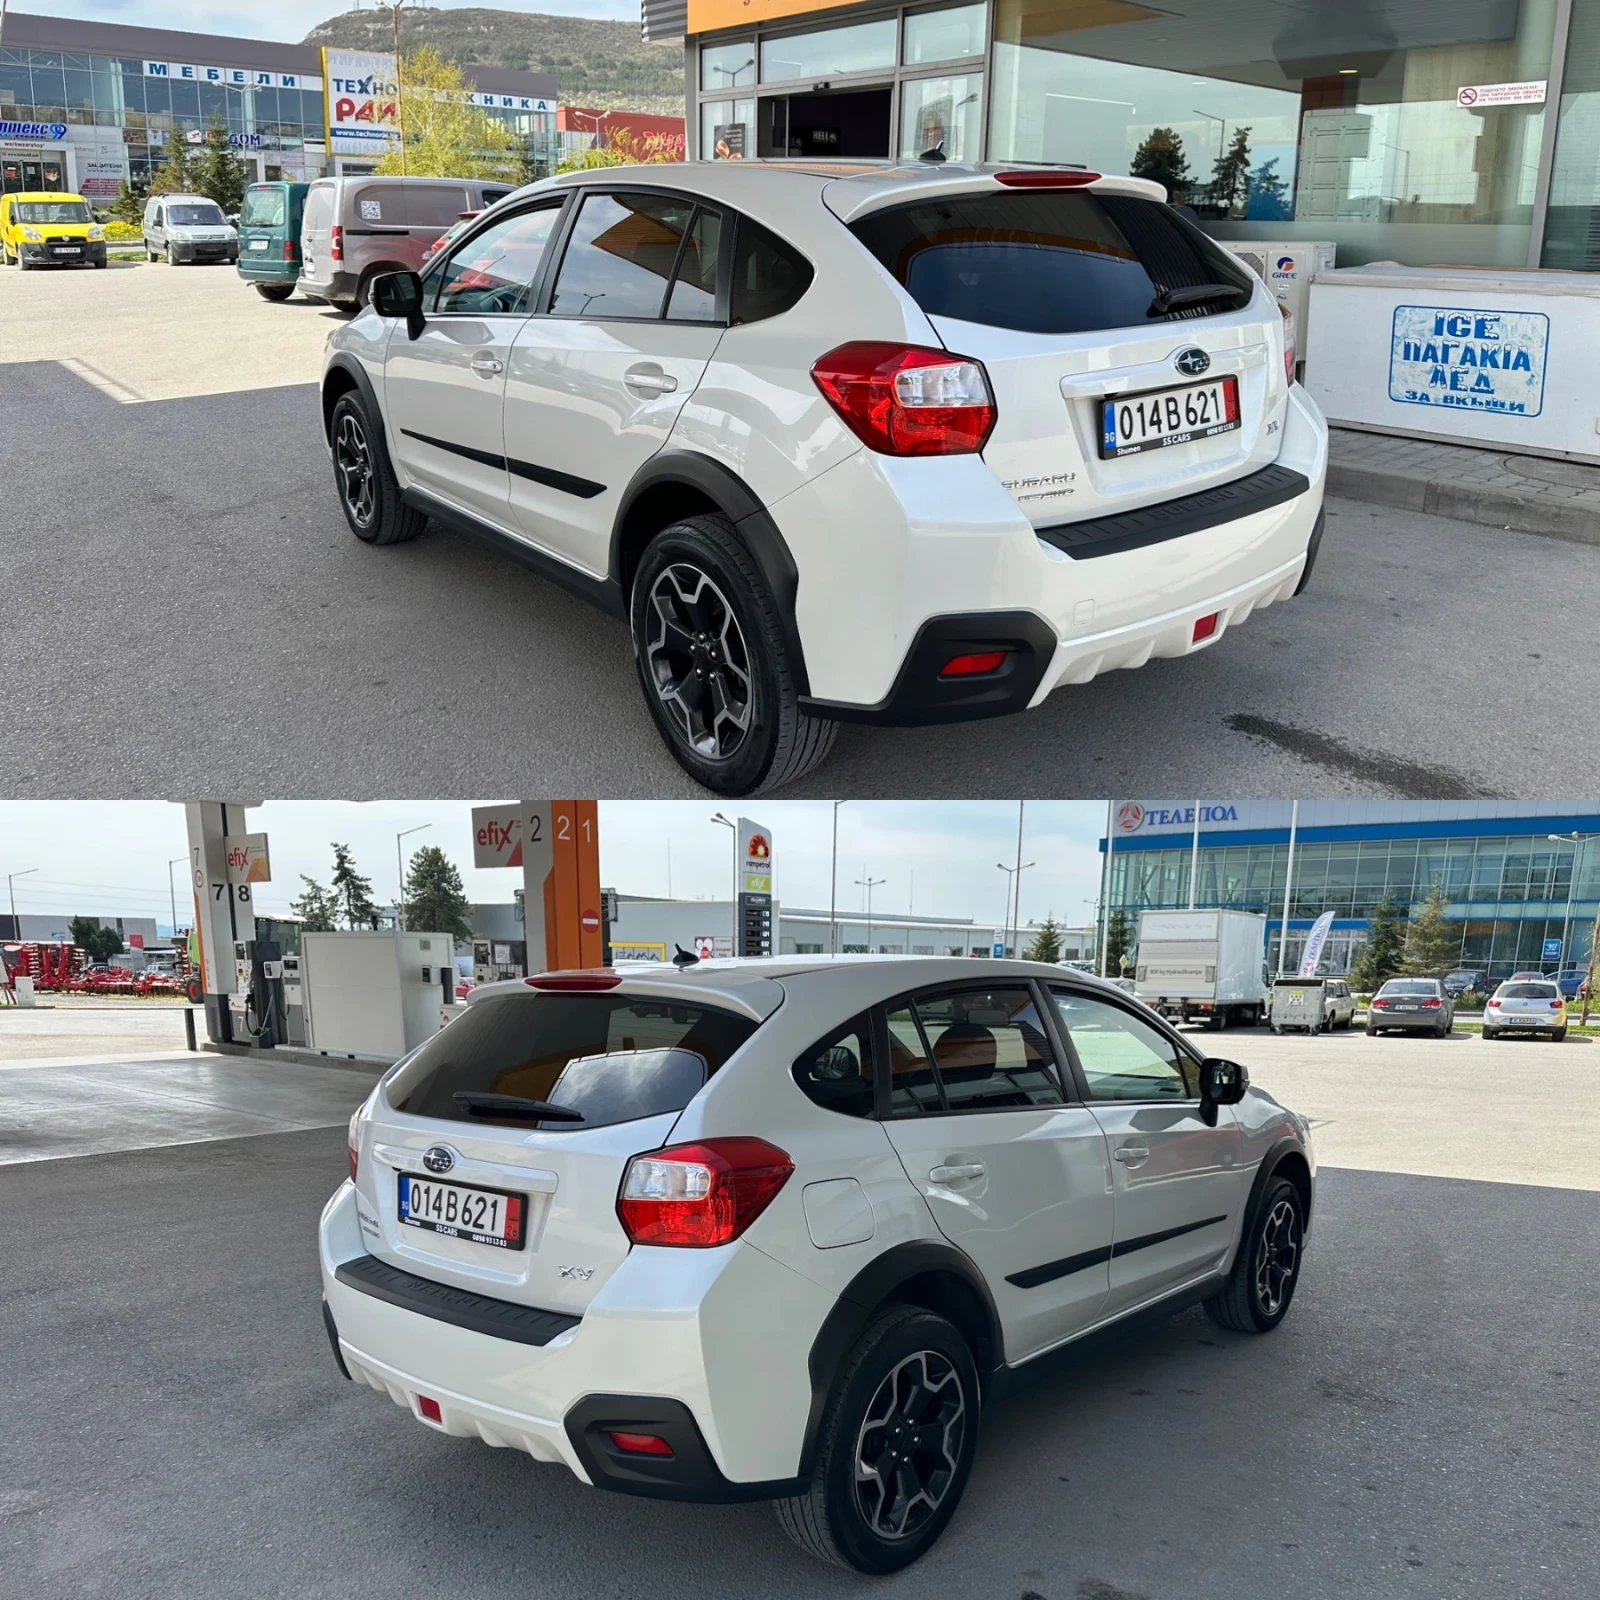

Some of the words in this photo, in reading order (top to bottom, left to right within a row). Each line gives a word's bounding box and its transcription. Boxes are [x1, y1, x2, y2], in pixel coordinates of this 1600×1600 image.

[148, 63, 295, 87] МЕБЕЛИ
[1272, 272, 1298, 280] GREE
[1433, 311, 1500, 340] ICE
[1429, 365, 1495, 394] ЛЕД
[1405, 390, 1431, 403] ЗА
[1105, 431, 1115, 444] BG
[1117, 445, 1141, 456] Shumen
[1001, 472, 1077, 489] SUBARU
[1145, 804, 1239, 826] ТЕЛЕПОЛ
[477, 819, 515, 853] efix
[529, 815, 542, 843] 2
[557, 815, 571, 841] 2
[582, 818, 591, 843] 1
[193, 847, 200, 867] 7
[227, 846, 250, 872] efix
[746, 861, 771, 869] rompetrol
[212, 883, 225, 901] 7
[237, 885, 250, 903] 8
[472, 1233, 486, 1243] 0898
[506, 1225, 518, 1237] 26
[557, 1264, 596, 1281] XV
